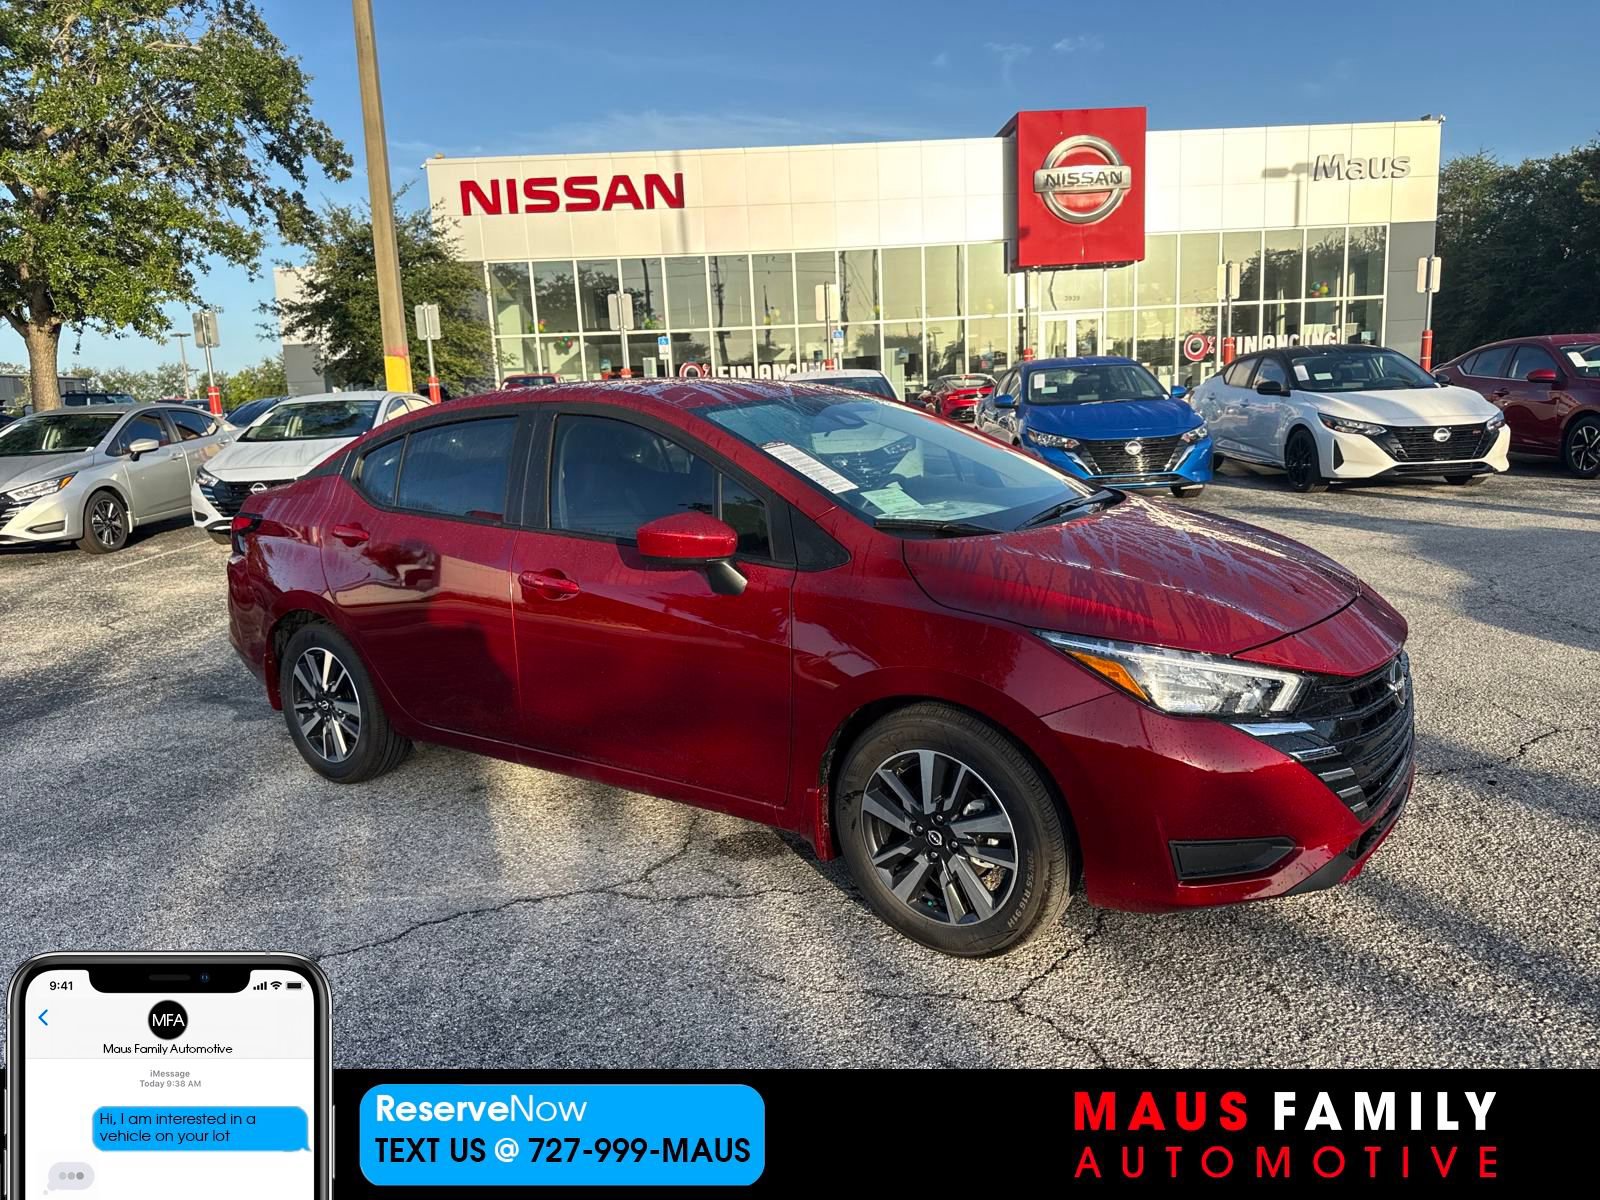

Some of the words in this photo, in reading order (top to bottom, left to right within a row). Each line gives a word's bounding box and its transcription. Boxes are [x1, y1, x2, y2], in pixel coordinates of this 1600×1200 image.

[1045, 171, 1123, 188] NISSAN
[1313, 153, 1411, 181] Maus
[460, 173, 685, 216] NISSAN
